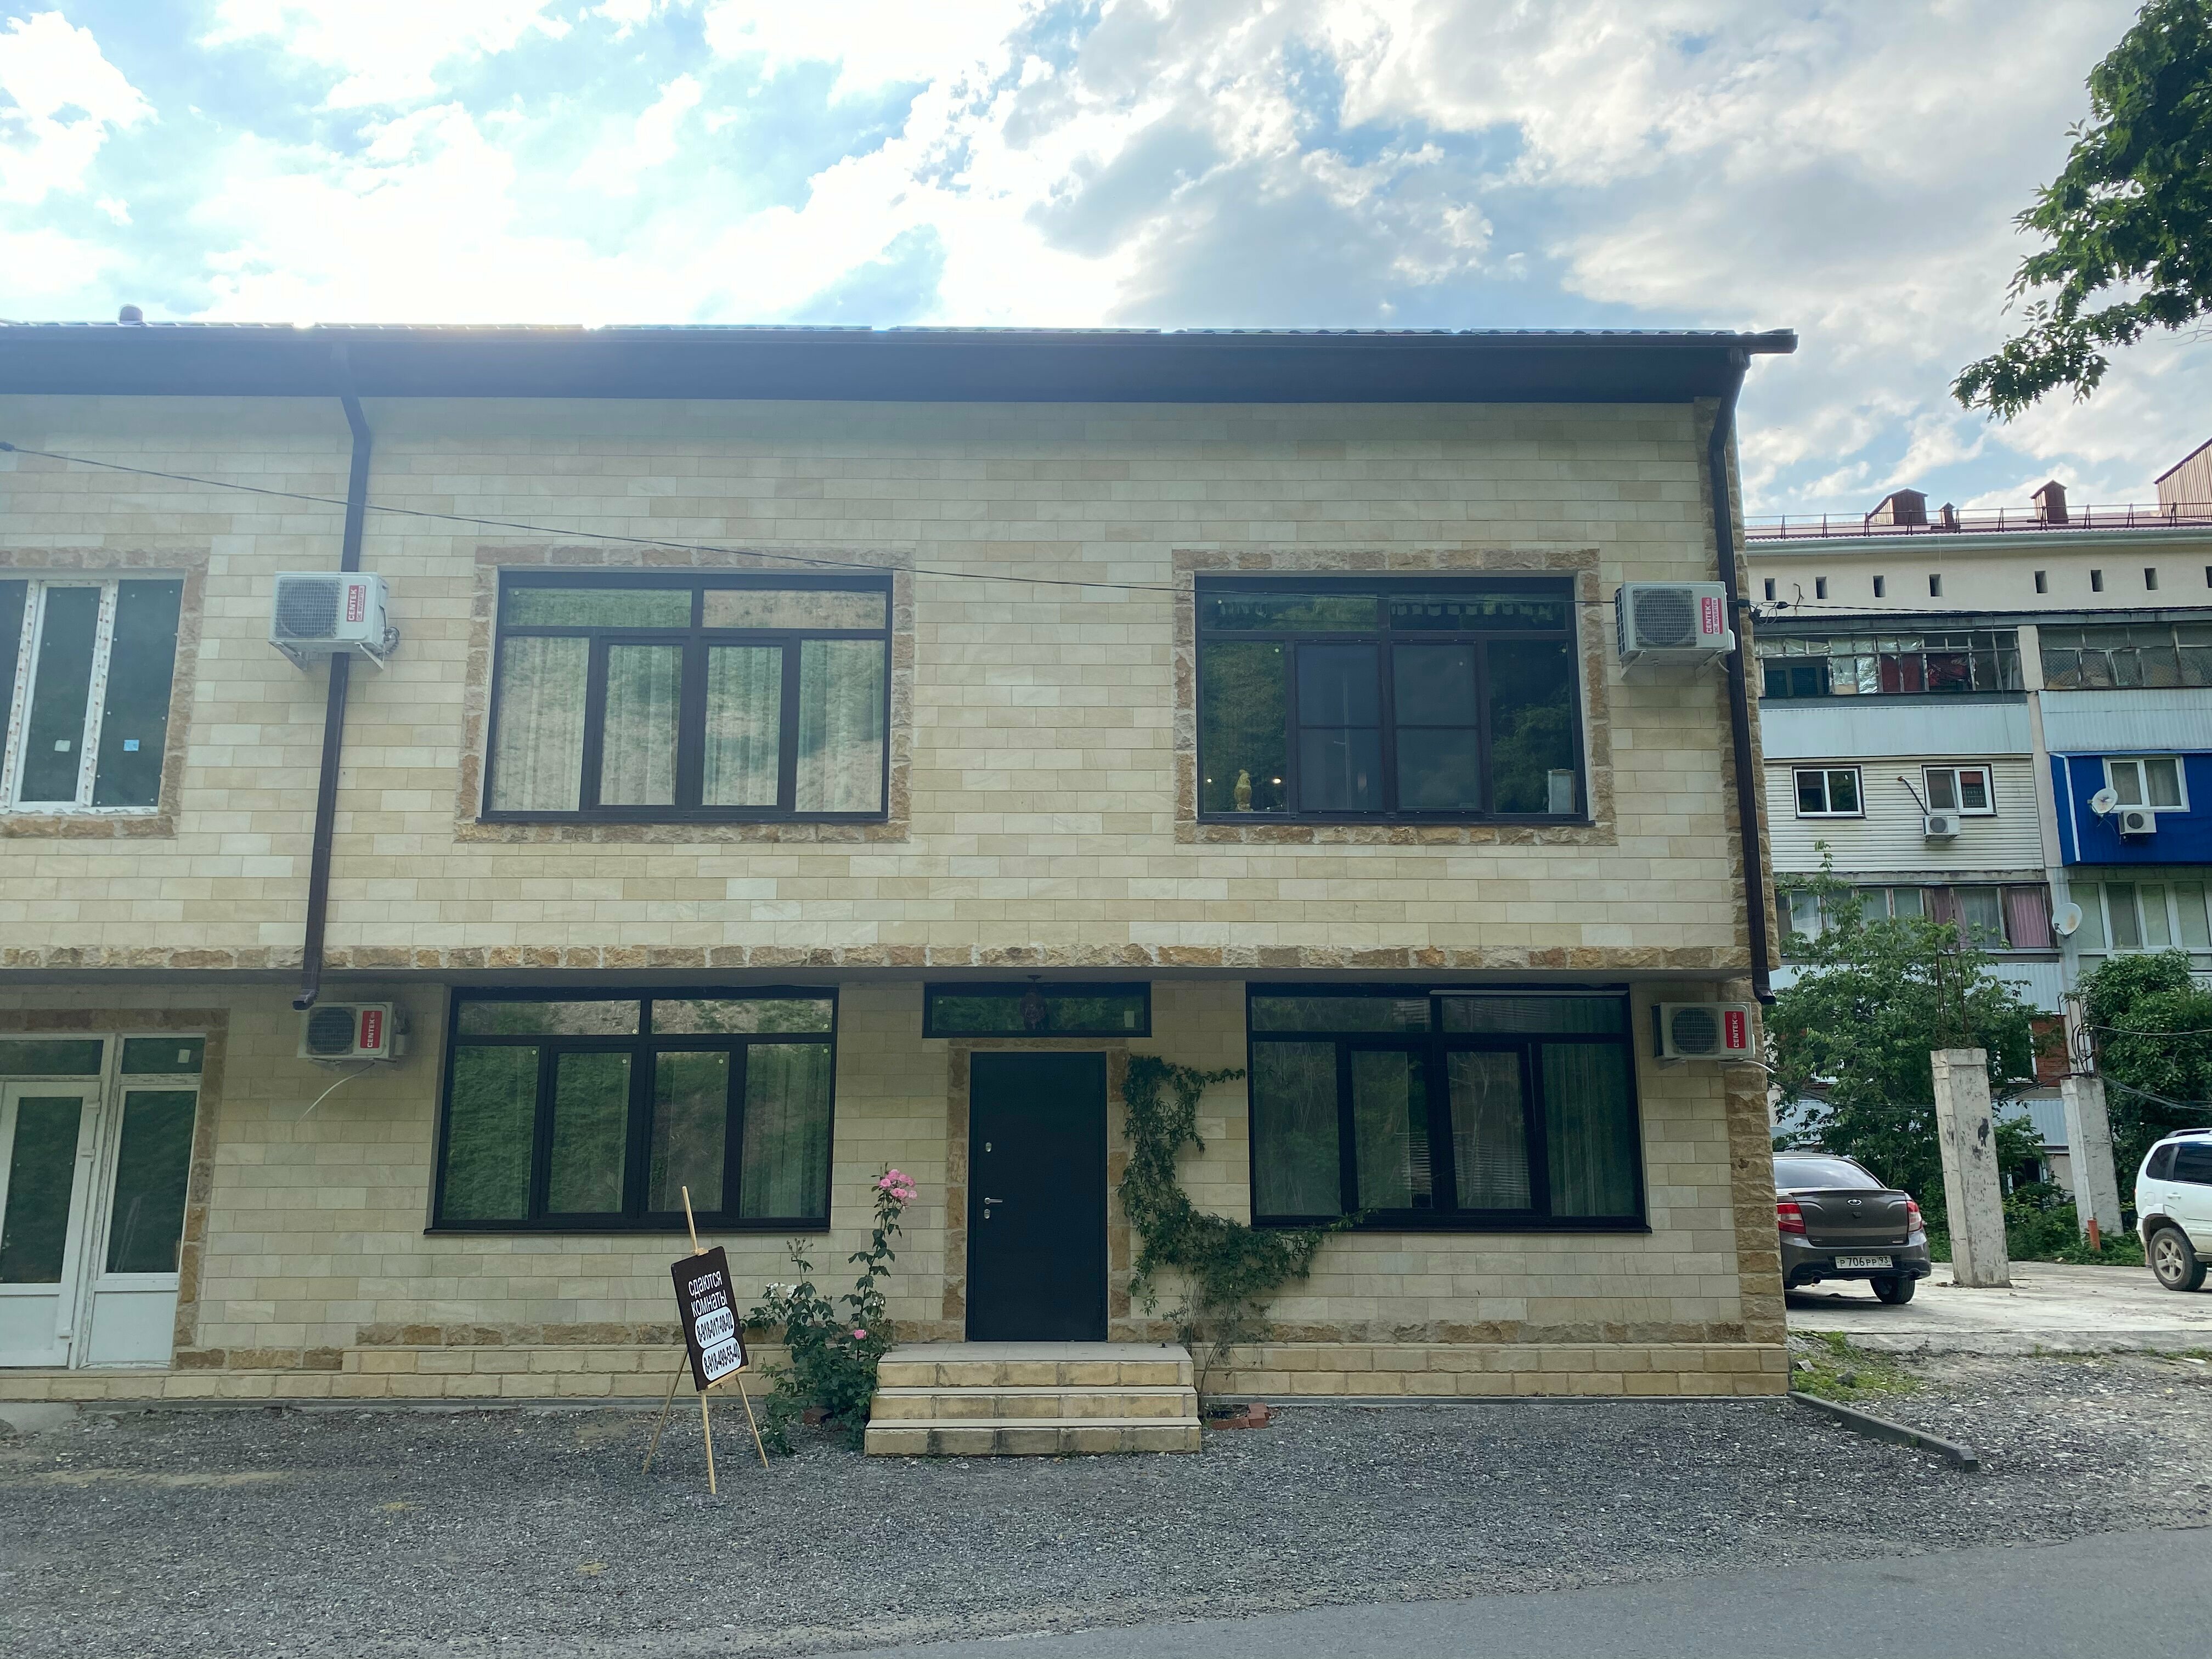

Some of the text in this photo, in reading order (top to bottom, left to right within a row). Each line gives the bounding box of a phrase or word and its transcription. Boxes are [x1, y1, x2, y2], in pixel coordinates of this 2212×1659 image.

[348, 588, 357, 620] CENTEK
[367, 1019, 375, 1048] CENTEK
[688, 1271, 723, 1299] сдаются
[691, 1289, 728, 1318] комнаты
[696, 1312, 733, 1343] 8-918-017-08-02
[703, 1342, 740, 1375] 8-918-499-55-40
